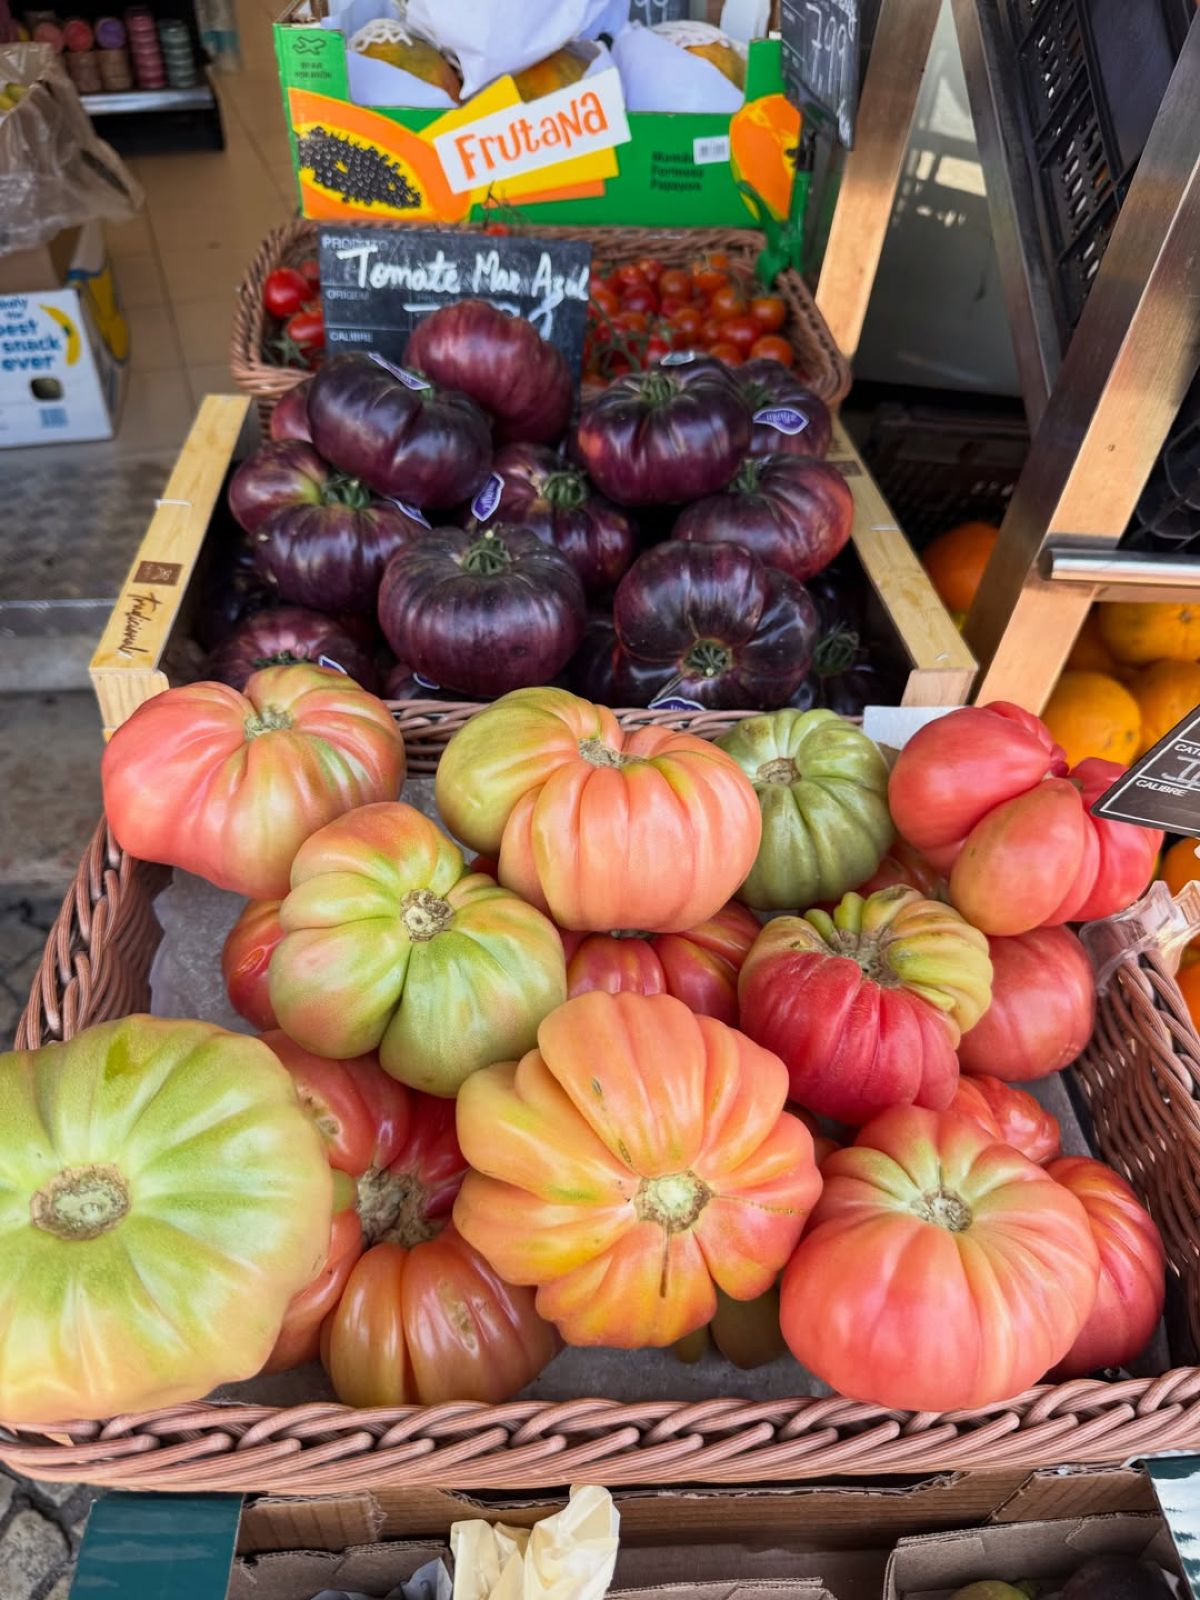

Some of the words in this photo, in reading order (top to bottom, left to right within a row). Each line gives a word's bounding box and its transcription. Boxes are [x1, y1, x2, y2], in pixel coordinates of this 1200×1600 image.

[337, 247, 461, 294] Tomate
[2, 336, 60, 352] snack
[2, 356, 54, 371] ever
[1136, 779, 1189, 797] CALIBRE
